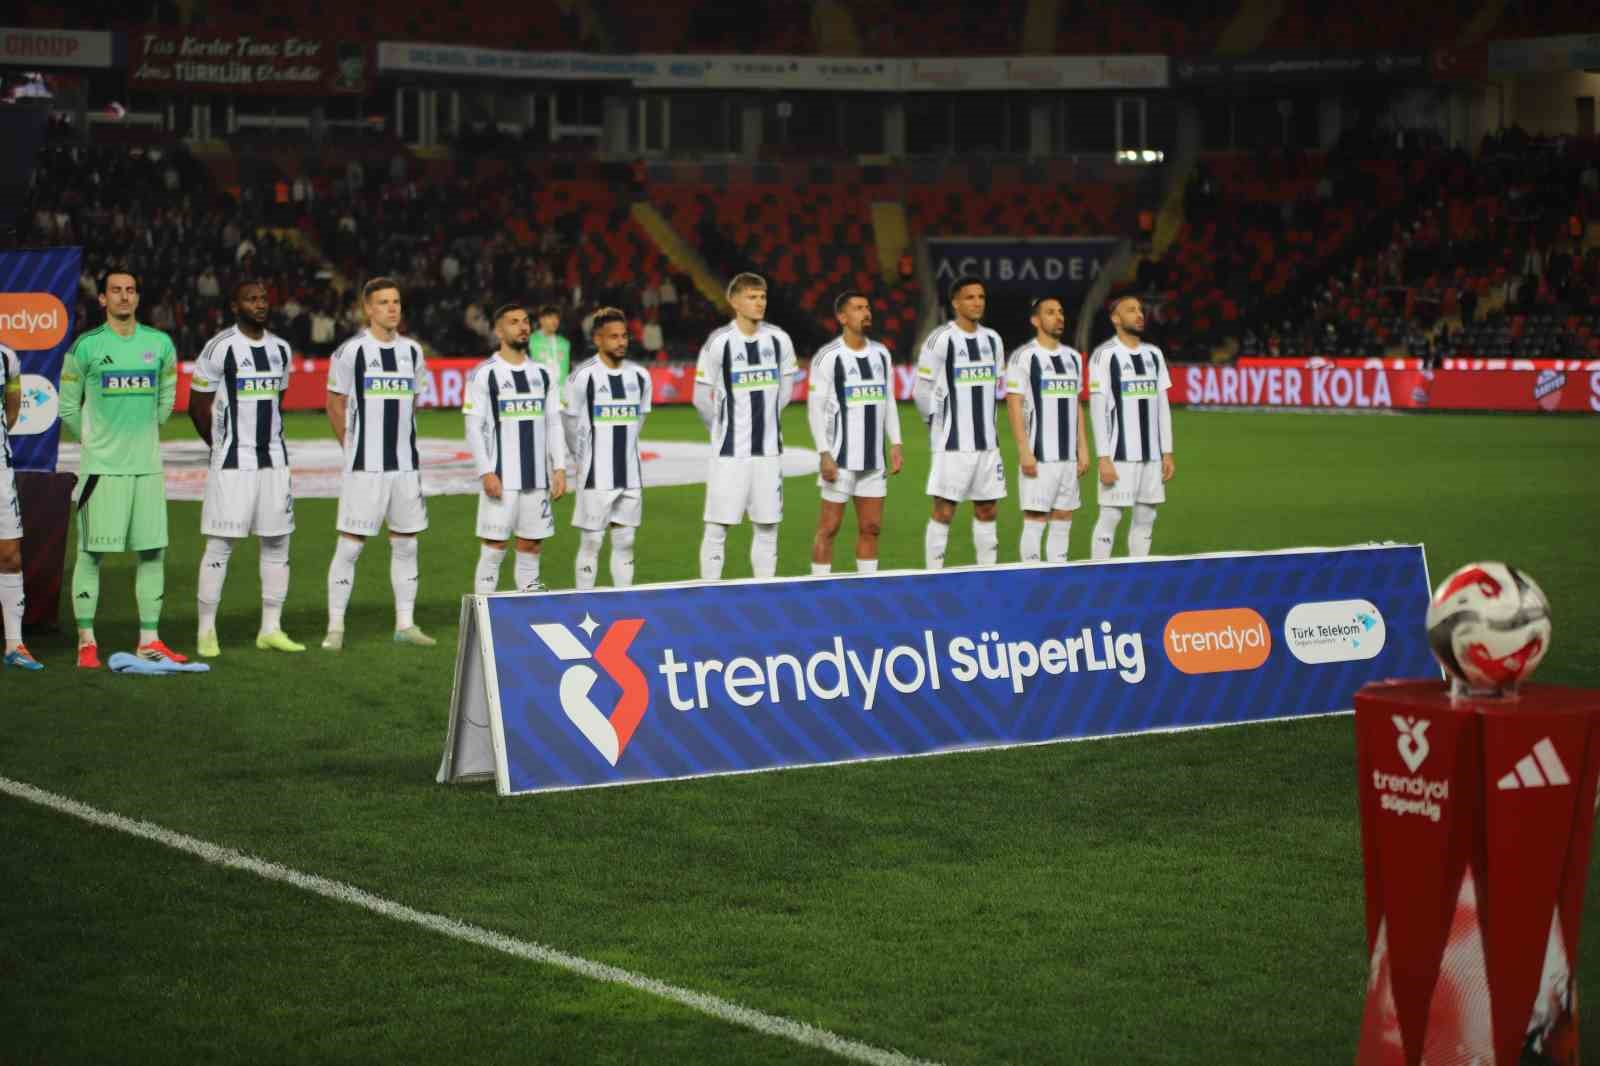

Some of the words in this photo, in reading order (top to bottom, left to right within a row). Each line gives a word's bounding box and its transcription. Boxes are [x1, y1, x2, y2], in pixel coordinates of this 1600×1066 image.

[738, 370, 773, 383] aksa
[958, 366, 992, 379] aksa
[107, 375, 151, 388] aksa
[243, 377, 280, 390] aksa
[371, 378, 408, 391] aksa
[1047, 378, 1076, 391] aksa
[1127, 380, 1156, 393] aksa
[1186, 366, 1301, 406] SARIYER
[1312, 367, 1391, 407] KOLA
[851, 386, 884, 399] aksa
[504, 400, 542, 413] aksa
[601, 404, 637, 417] aksa
[1317, 624, 1360, 638] Telekom
[1169, 623, 1265, 654] trendyol
[658, 630, 940, 711] trendyol
[948, 621, 1146, 694] SüperLig
[1373, 769, 1449, 799] trendyol
